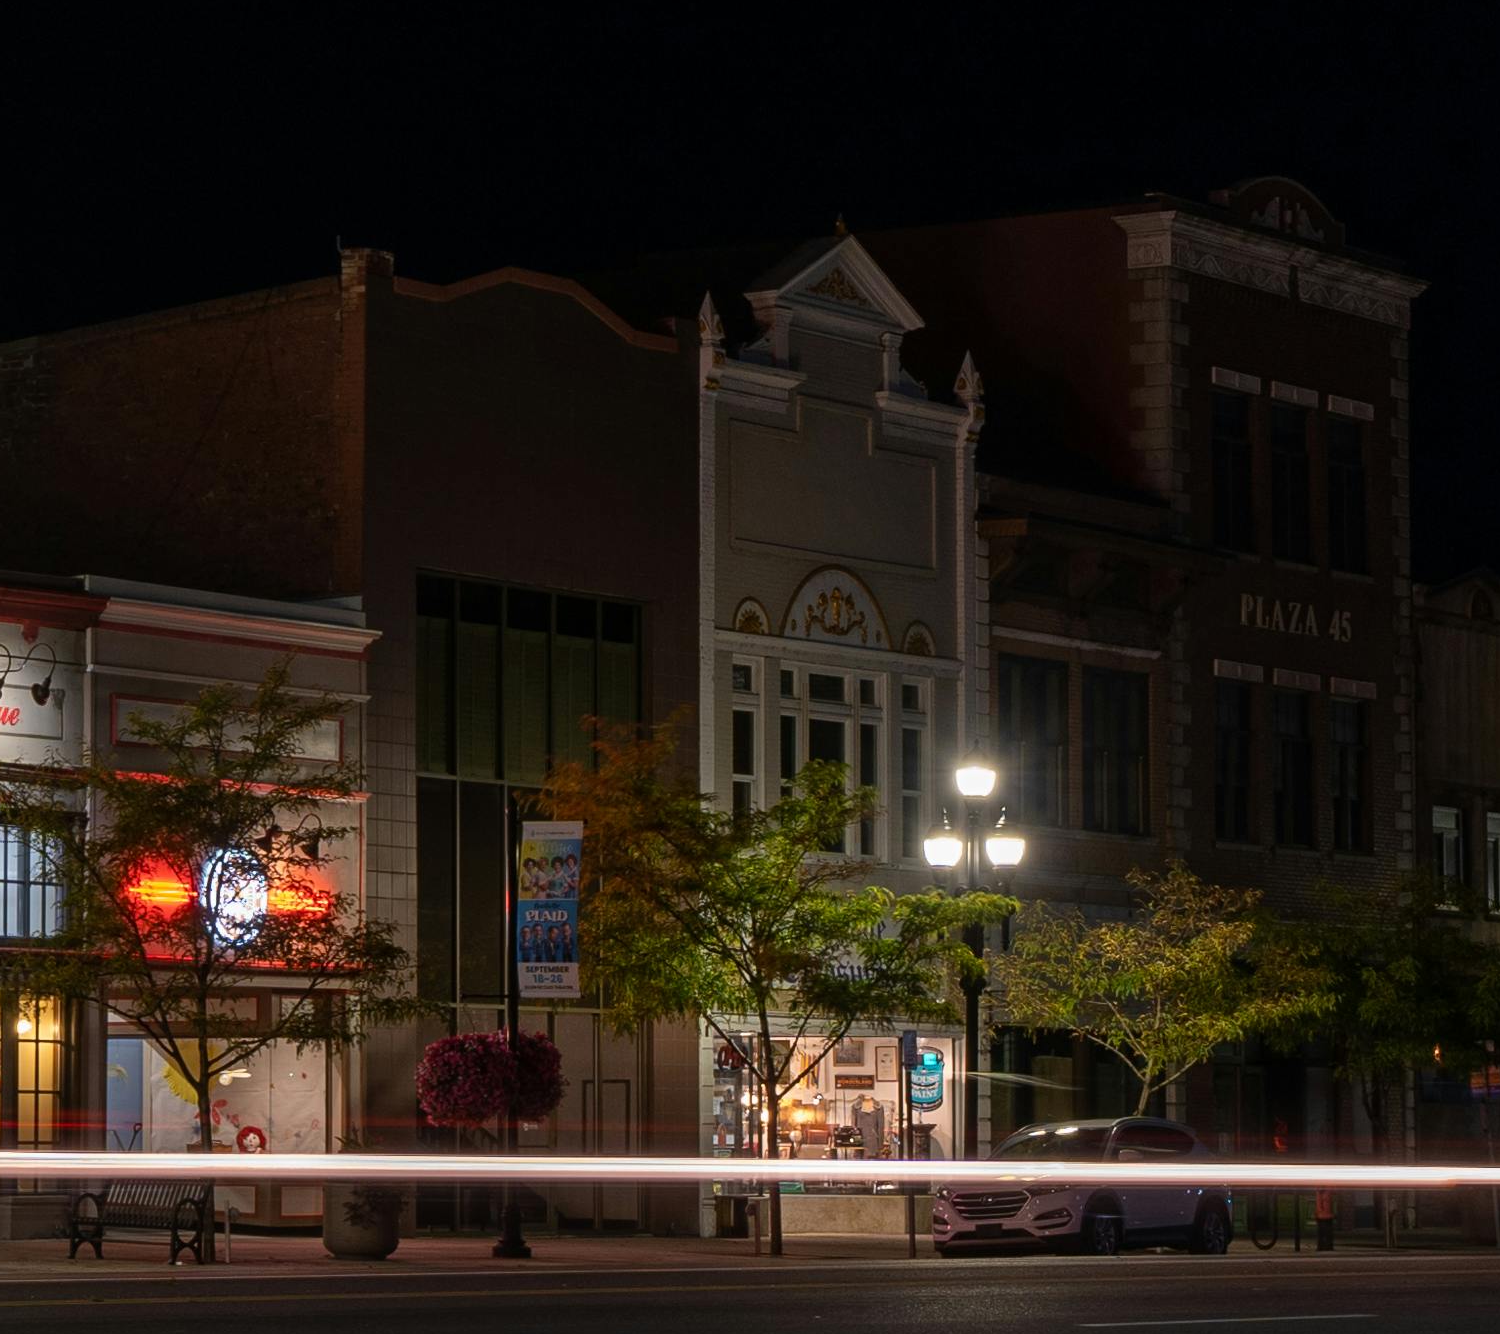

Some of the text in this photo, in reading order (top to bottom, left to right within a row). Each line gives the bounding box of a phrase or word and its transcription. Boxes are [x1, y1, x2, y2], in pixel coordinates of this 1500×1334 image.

[1240, 592, 1352, 643] PLAZA 45
[526, 909, 568, 922] PLAID
[526, 965, 570, 973] SEPTEMBER
